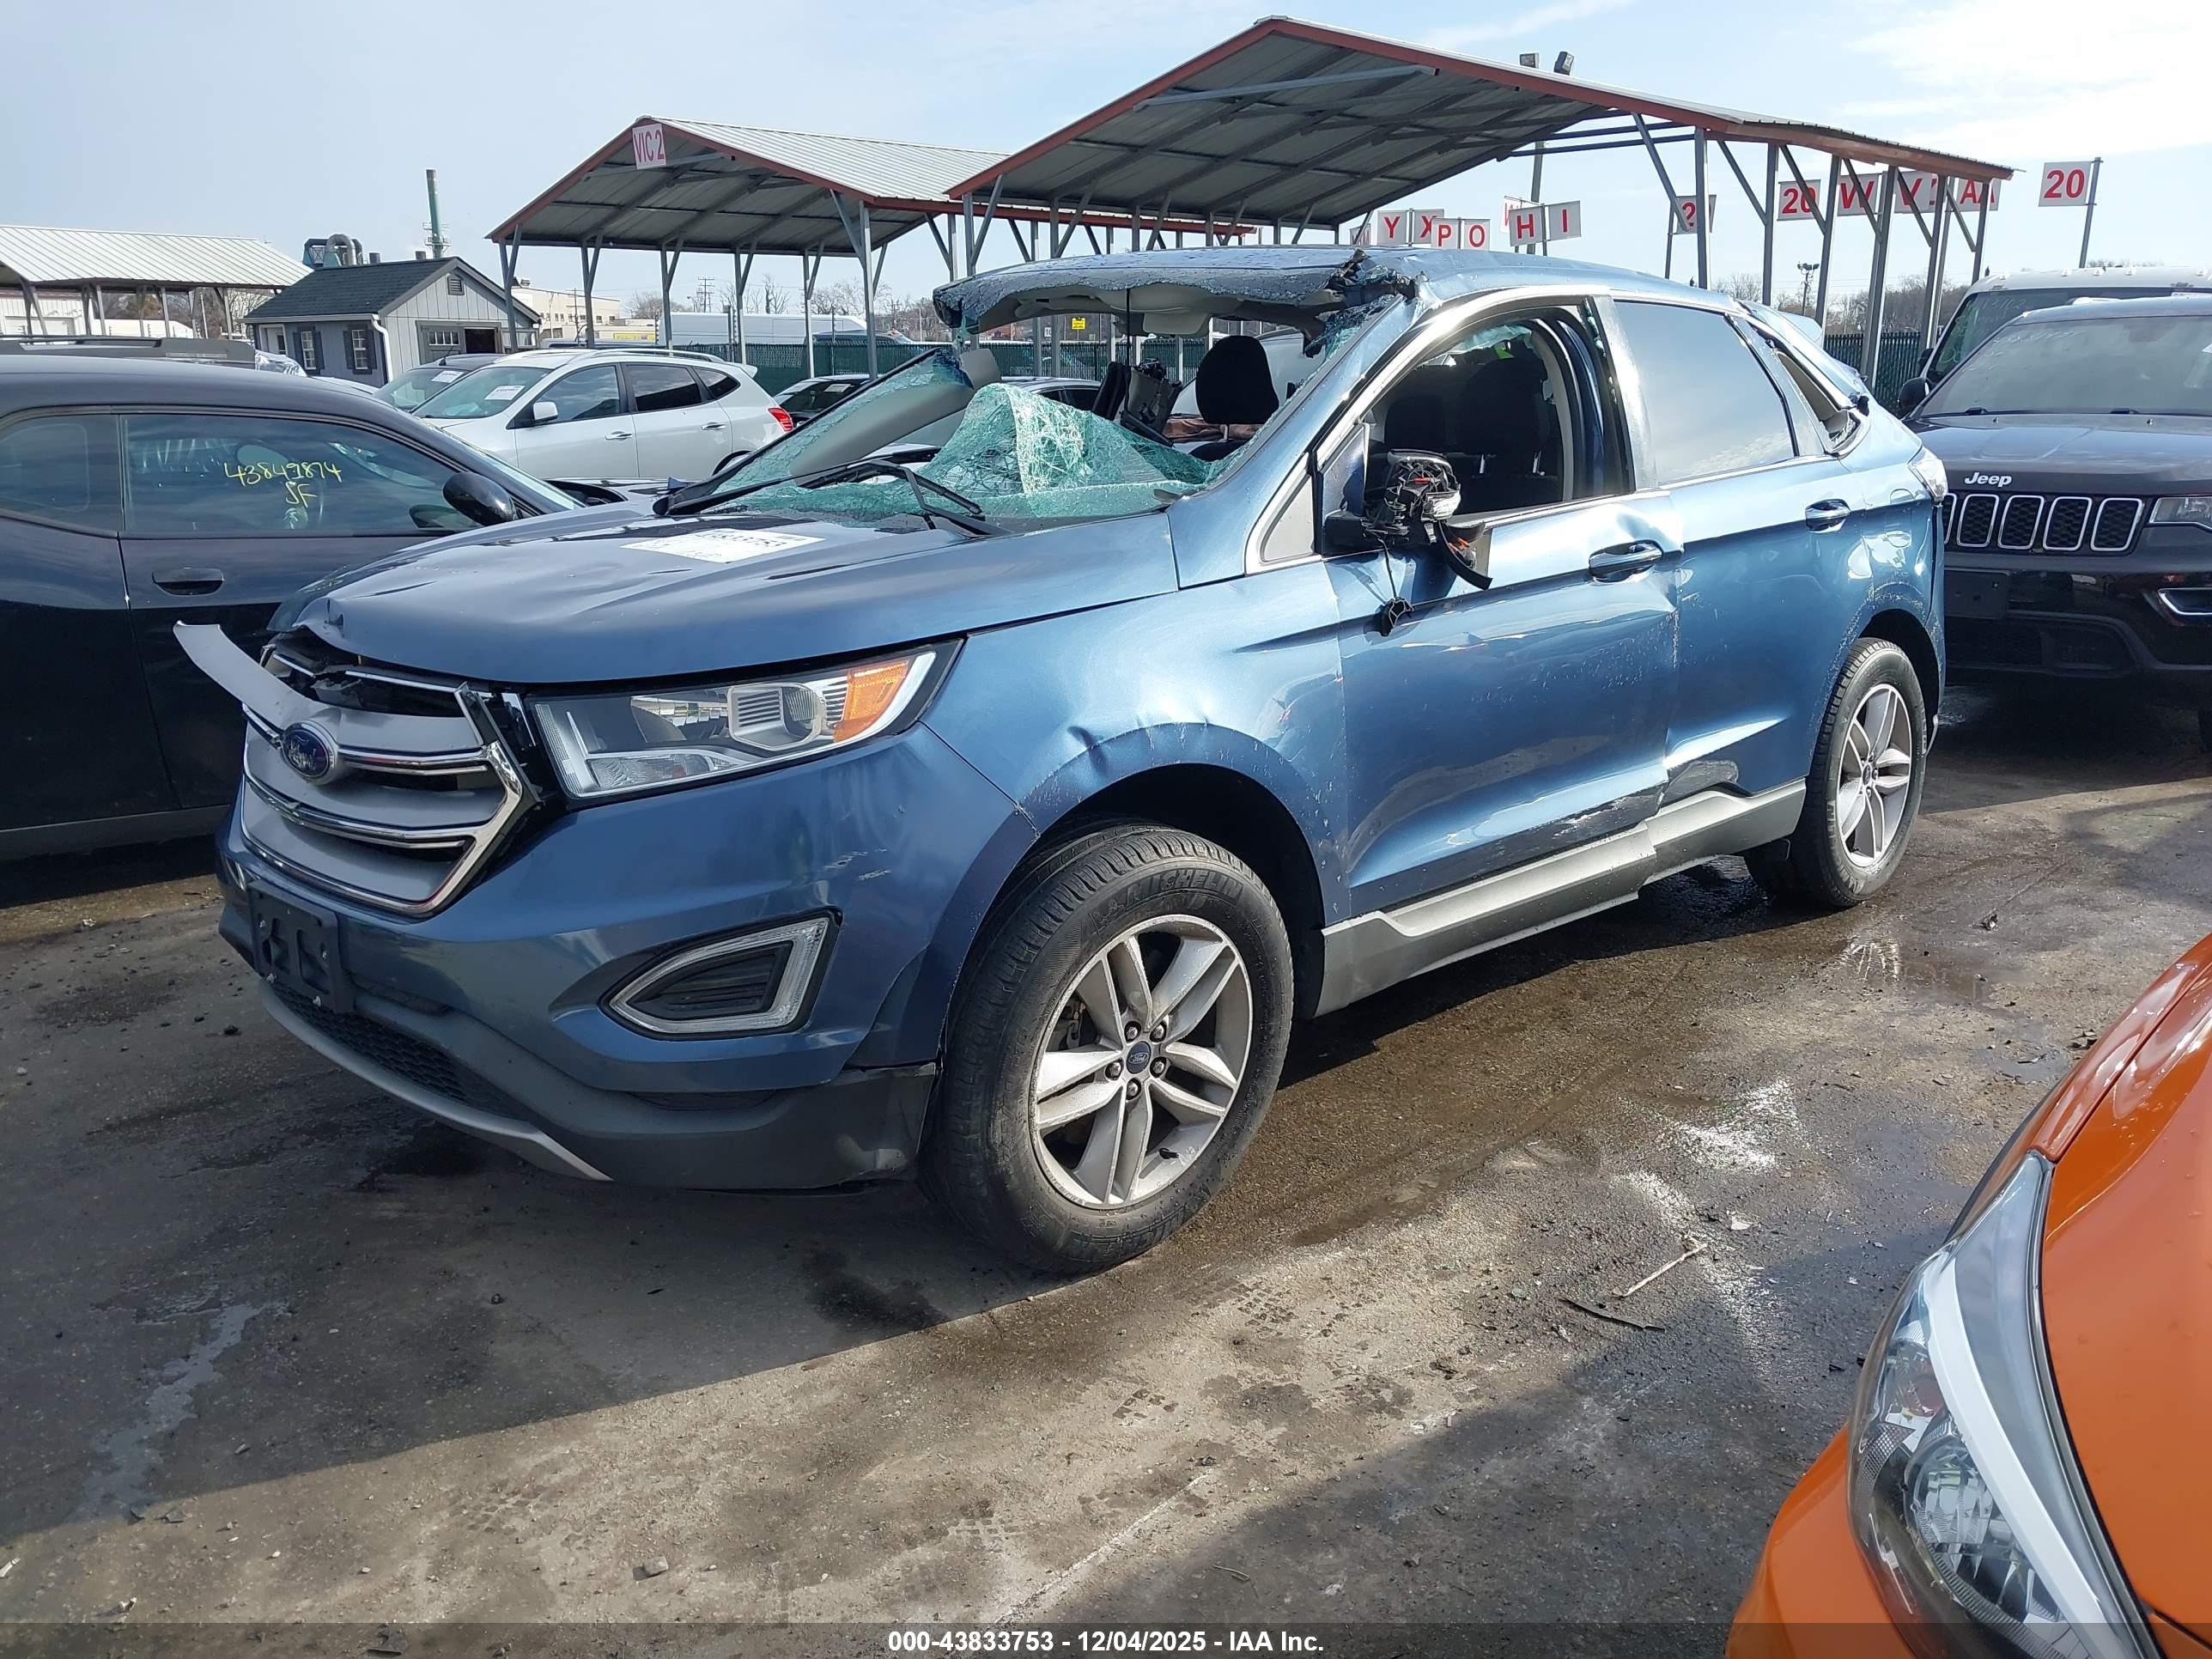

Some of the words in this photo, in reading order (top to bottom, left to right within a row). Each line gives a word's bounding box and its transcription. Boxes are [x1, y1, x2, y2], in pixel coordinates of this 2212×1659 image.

[634, 131, 653, 163] VIC
[655, 130, 665, 160] 2
[1840, 180, 1875, 209] W
[2044, 169, 2085, 198] 20
[1782, 187, 1816, 214] 20
[1384, 216, 1401, 239] Y
[1420, 216, 1437, 238] X
[1516, 213, 1534, 240] H
[1562, 209, 1568, 234] I
[1437, 224, 1452, 247] P
[1964, 471, 2012, 488] Jeep
